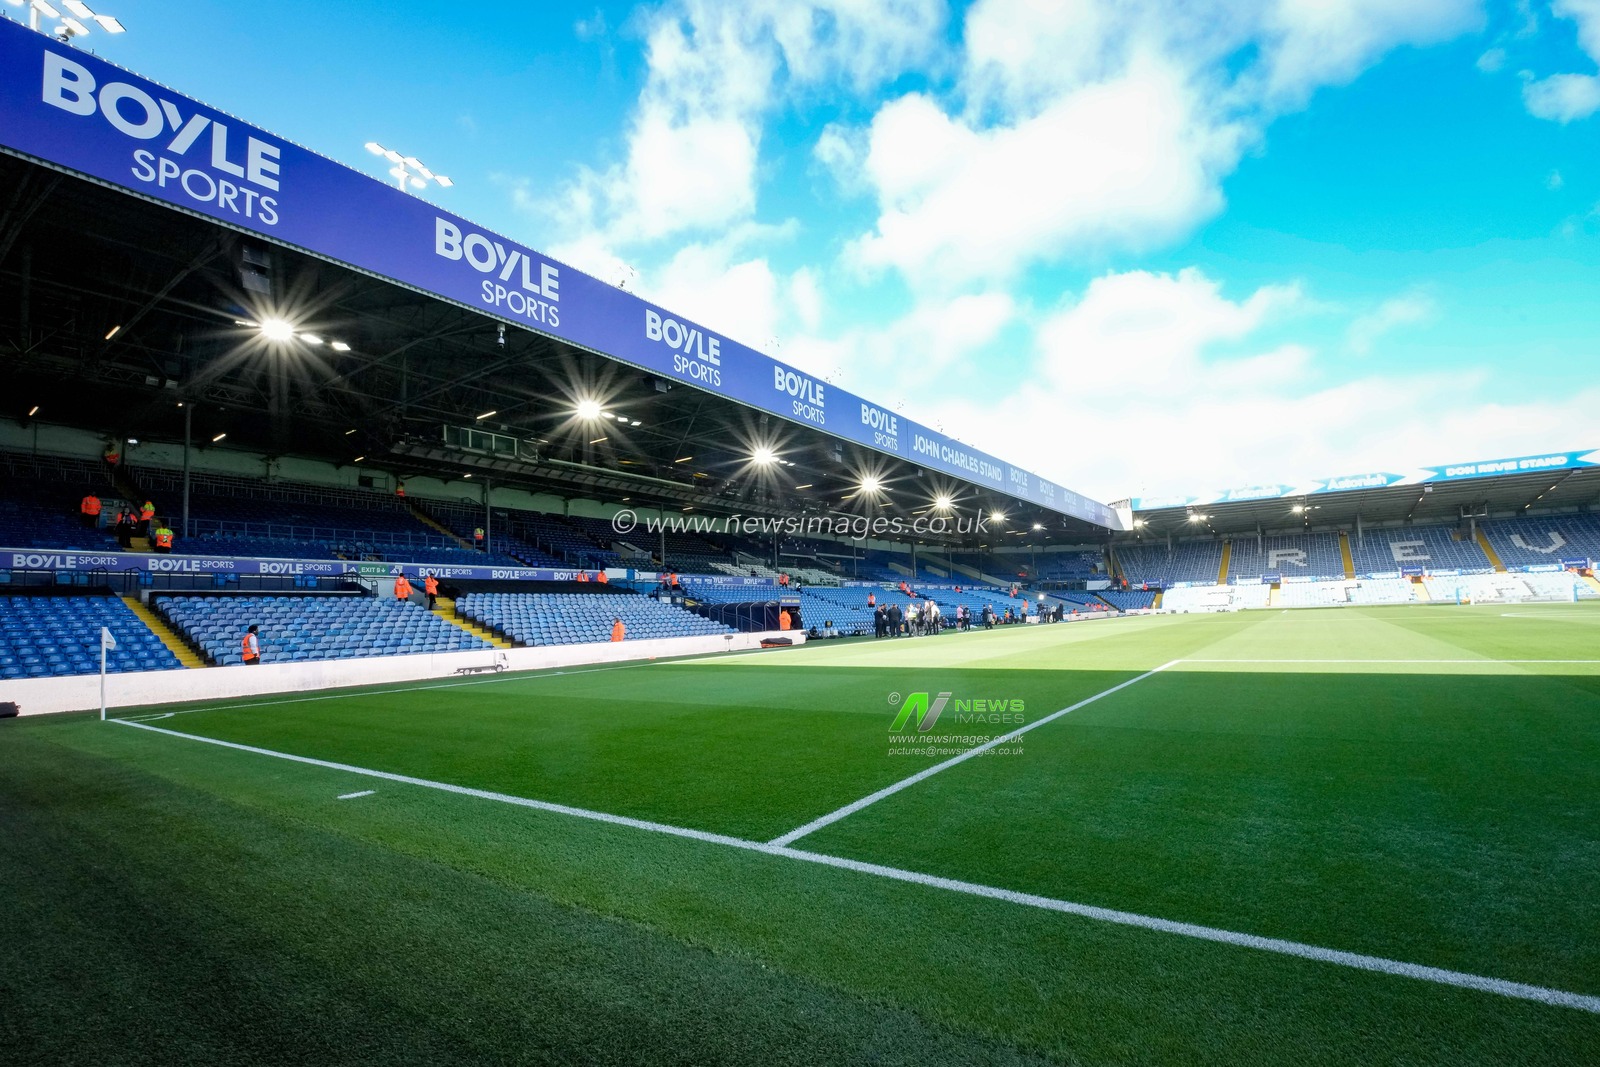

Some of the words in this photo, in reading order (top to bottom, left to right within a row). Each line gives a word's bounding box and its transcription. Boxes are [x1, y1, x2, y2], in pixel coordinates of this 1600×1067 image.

[43, 50, 280, 192] BOYLE
[131, 149, 279, 226] SPORTS
[435, 216, 560, 302] BOYLE
[481, 280, 560, 327] SPORTS
[645, 309, 721, 367] BOYLE
[673, 354, 721, 387] SPORTS
[774, 365, 825, 408] BOYLE
[792, 400, 825, 425] SPORTS
[861, 403, 897, 436] BOYLE
[874, 431, 898, 451] SPORTS
[913, 434, 940, 459] JOHN
[941, 446, 979, 474] CHARLES
[979, 461, 1002, 482] STAND
[1446, 466, 1476, 478] DON
[1478, 461, 1518, 474] REVIE
[1519, 456, 1568, 469] STAND
[1010, 467, 1028, 487] BOYLE
[1327, 474, 1387, 490] Astonish
[12, 553, 77, 569] BOYLE
[78, 556, 118, 566] SPORTS
[148, 558, 200, 572] BOYLE
[201, 560, 235, 569] SPORTS
[259, 562, 304, 575] BOYLE
[304, 563, 332, 572] SPORTS
[418, 567, 452, 578] BOYLE
[452, 568, 473, 576] SPORTS
[491, 569, 520, 580] BOYLE
[520, 570, 538, 578] SPORTS
[553, 571, 578, 581] BOYLE
